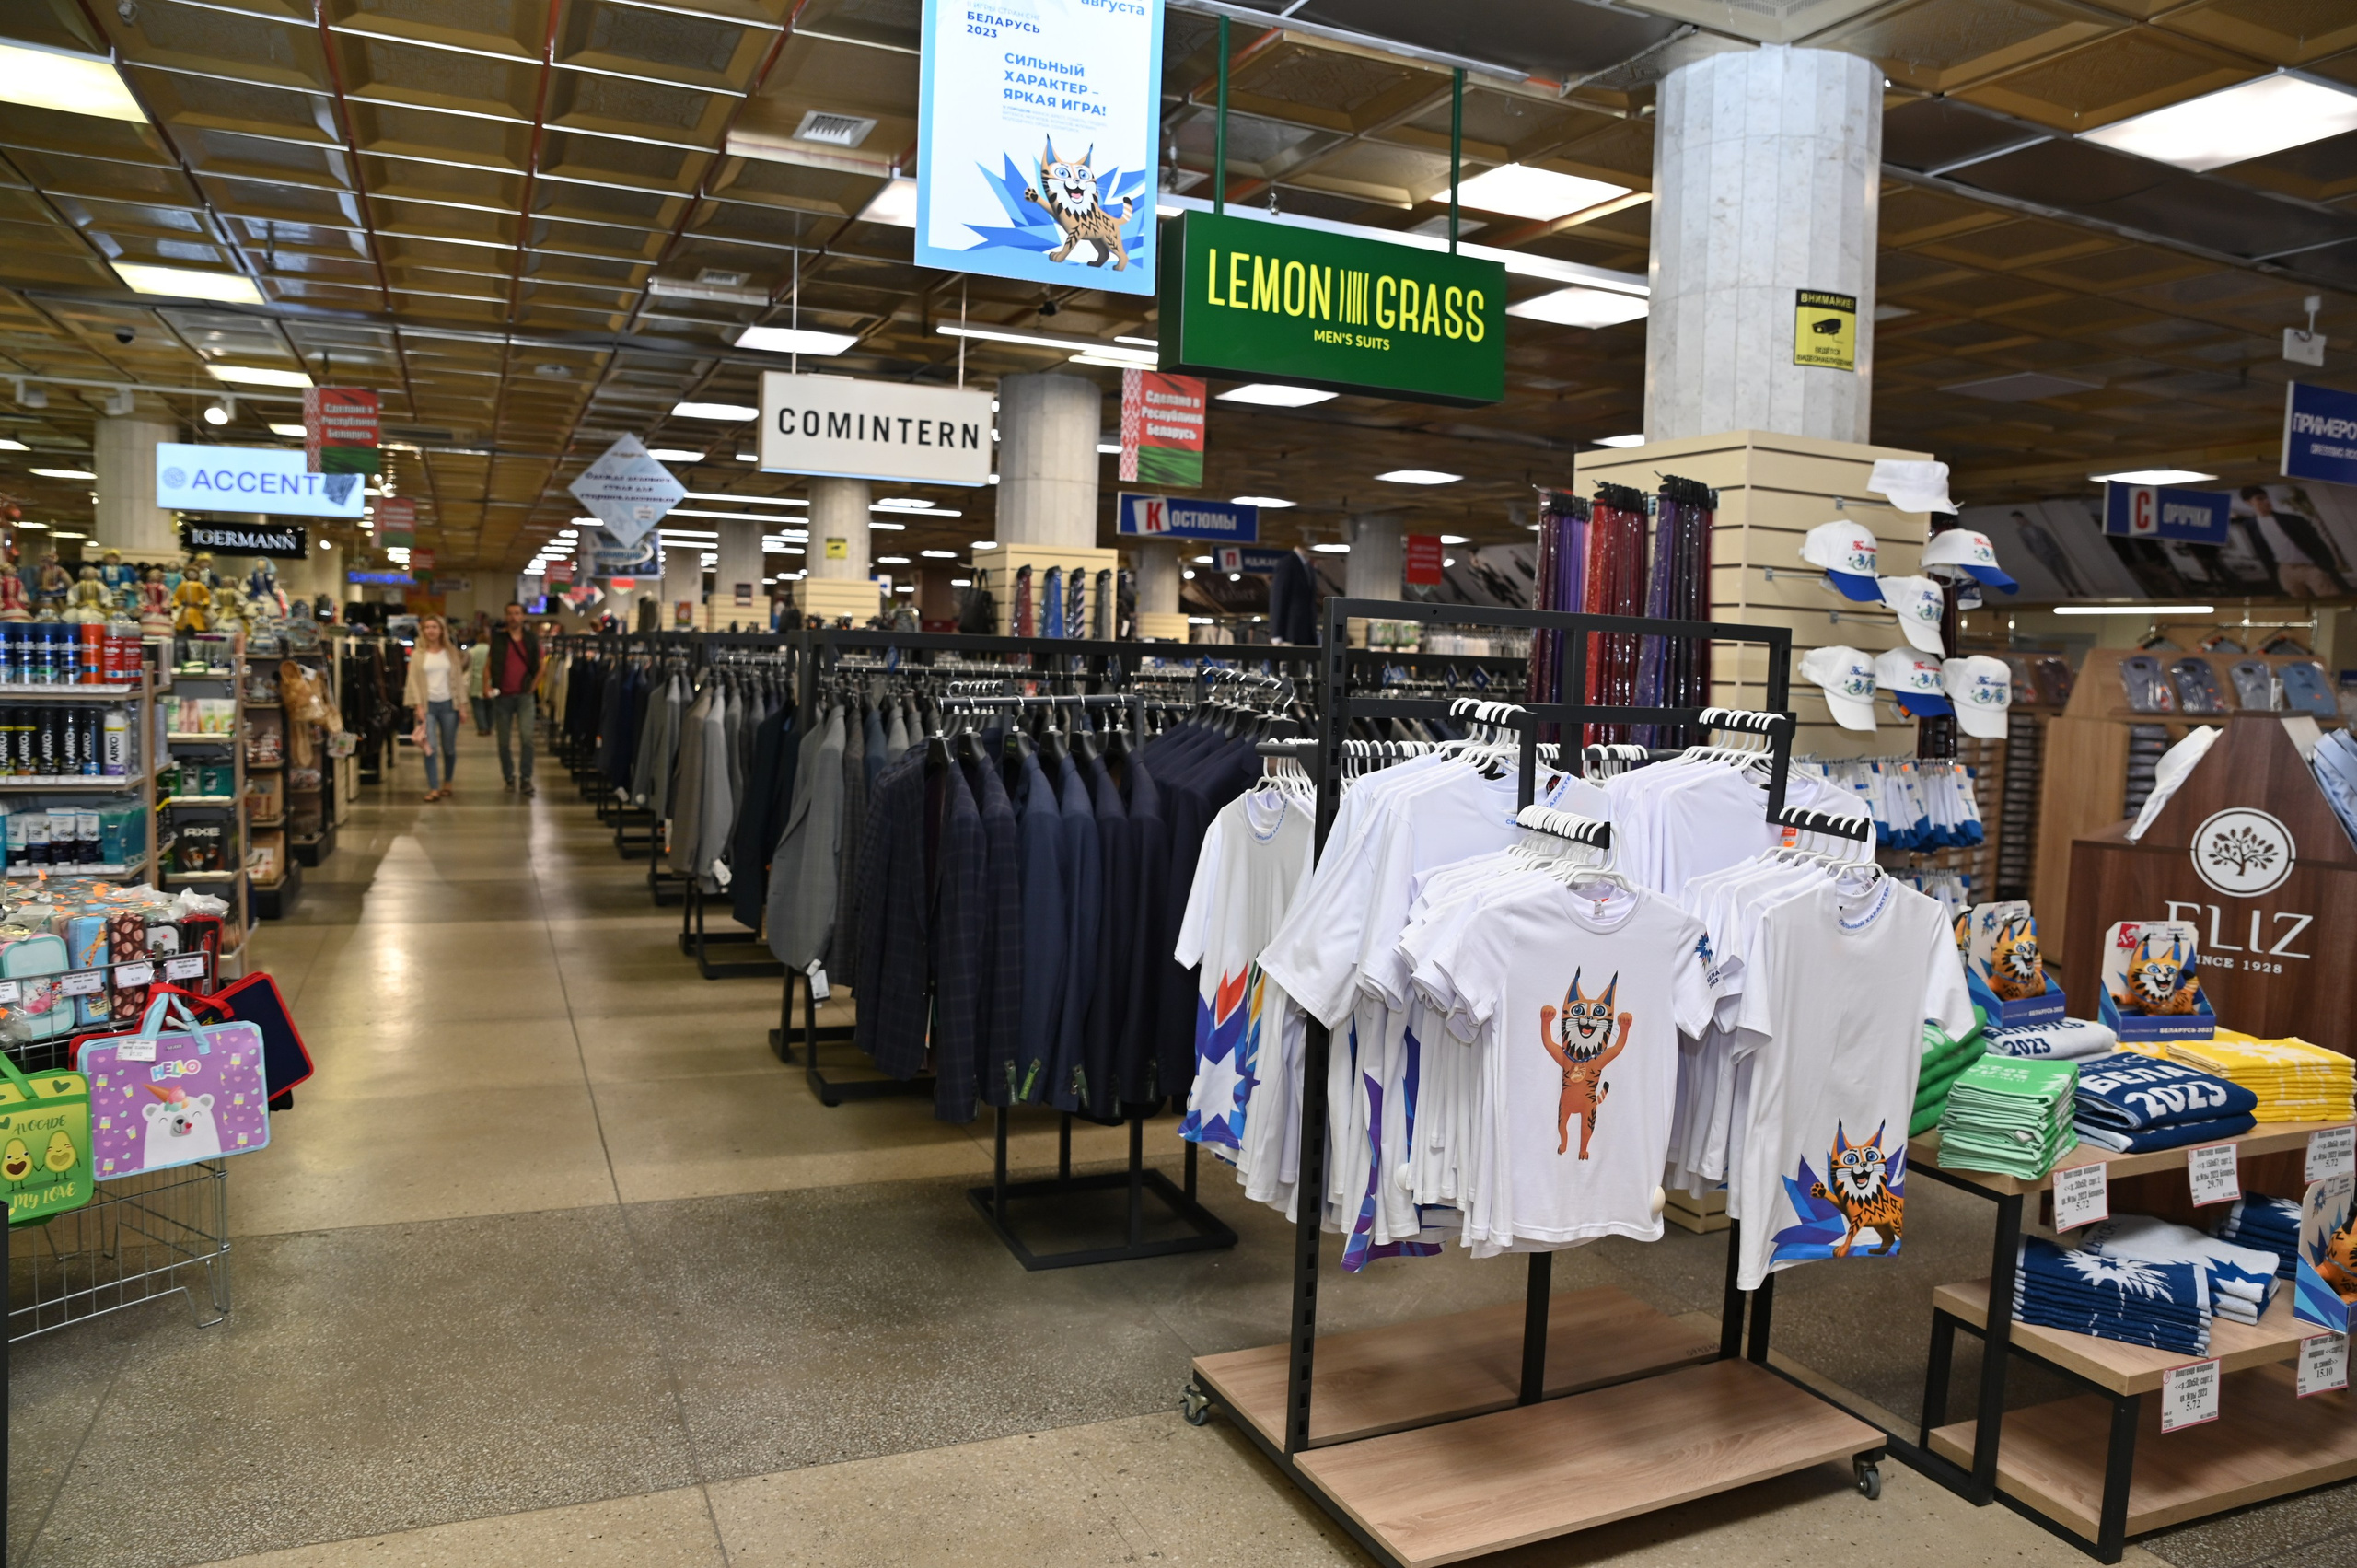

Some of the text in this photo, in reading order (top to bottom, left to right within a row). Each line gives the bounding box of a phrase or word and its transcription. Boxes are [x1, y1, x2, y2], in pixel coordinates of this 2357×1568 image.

[967, 11, 1040, 34] БЕЛАРУСЬ
[967, 24, 998, 39] 2023
[1004, 52, 1085, 77] СИЛЬНЫЙ
[1004, 70, 1088, 95] ХАРАКТЕР
[1003, 88, 1107, 116] ЯРКАЯ ИГРА!
[1208, 248, 1484, 342] LEMON GRASS
[1800, 292, 1854, 310] ВНИМАНИЕ!
[1313, 329, 1390, 351] MEN'S SUITS
[1145, 390, 1201, 408] Сделано в
[321, 416, 378, 427] Республике
[1141, 406, 1203, 424] Республике
[326, 428, 373, 440] Беларусь
[778, 407, 980, 449] COMINTERN
[1146, 423, 1197, 440] Беларусь
[192, 469, 320, 495] ACCENT
[1146, 501, 1237, 531] КОСТЮМЫ
[19, 735, 30, 763] ARKO
[41, 733, 53, 761] ARKO
[64, 732, 75, 760] ARKO
[82, 732, 92, 760] ARKO
[110, 736, 119, 762] ARKO
[1546, 774, 1571, 808] АРАКТЕ
[183, 827, 221, 837] AXE
[1865, 886, 1889, 923] ХАРАКТЕР
[2195, 954, 2282, 975] INCE 1928
[2003, 1037, 2051, 1056] 2023
[150, 1058, 202, 1082] HELLO
[2124, 1080, 2227, 1119] 2023
[2325, 1158, 2339, 1167] 5.72
[42, 1180, 77, 1204] LOVE
[2207, 1179, 2223, 1189] 29.70
[2076, 1200, 2090, 1211] 5.72
[2316, 1366, 2333, 1379] 15.10
[2186, 1399, 2200, 1411] 5.72
